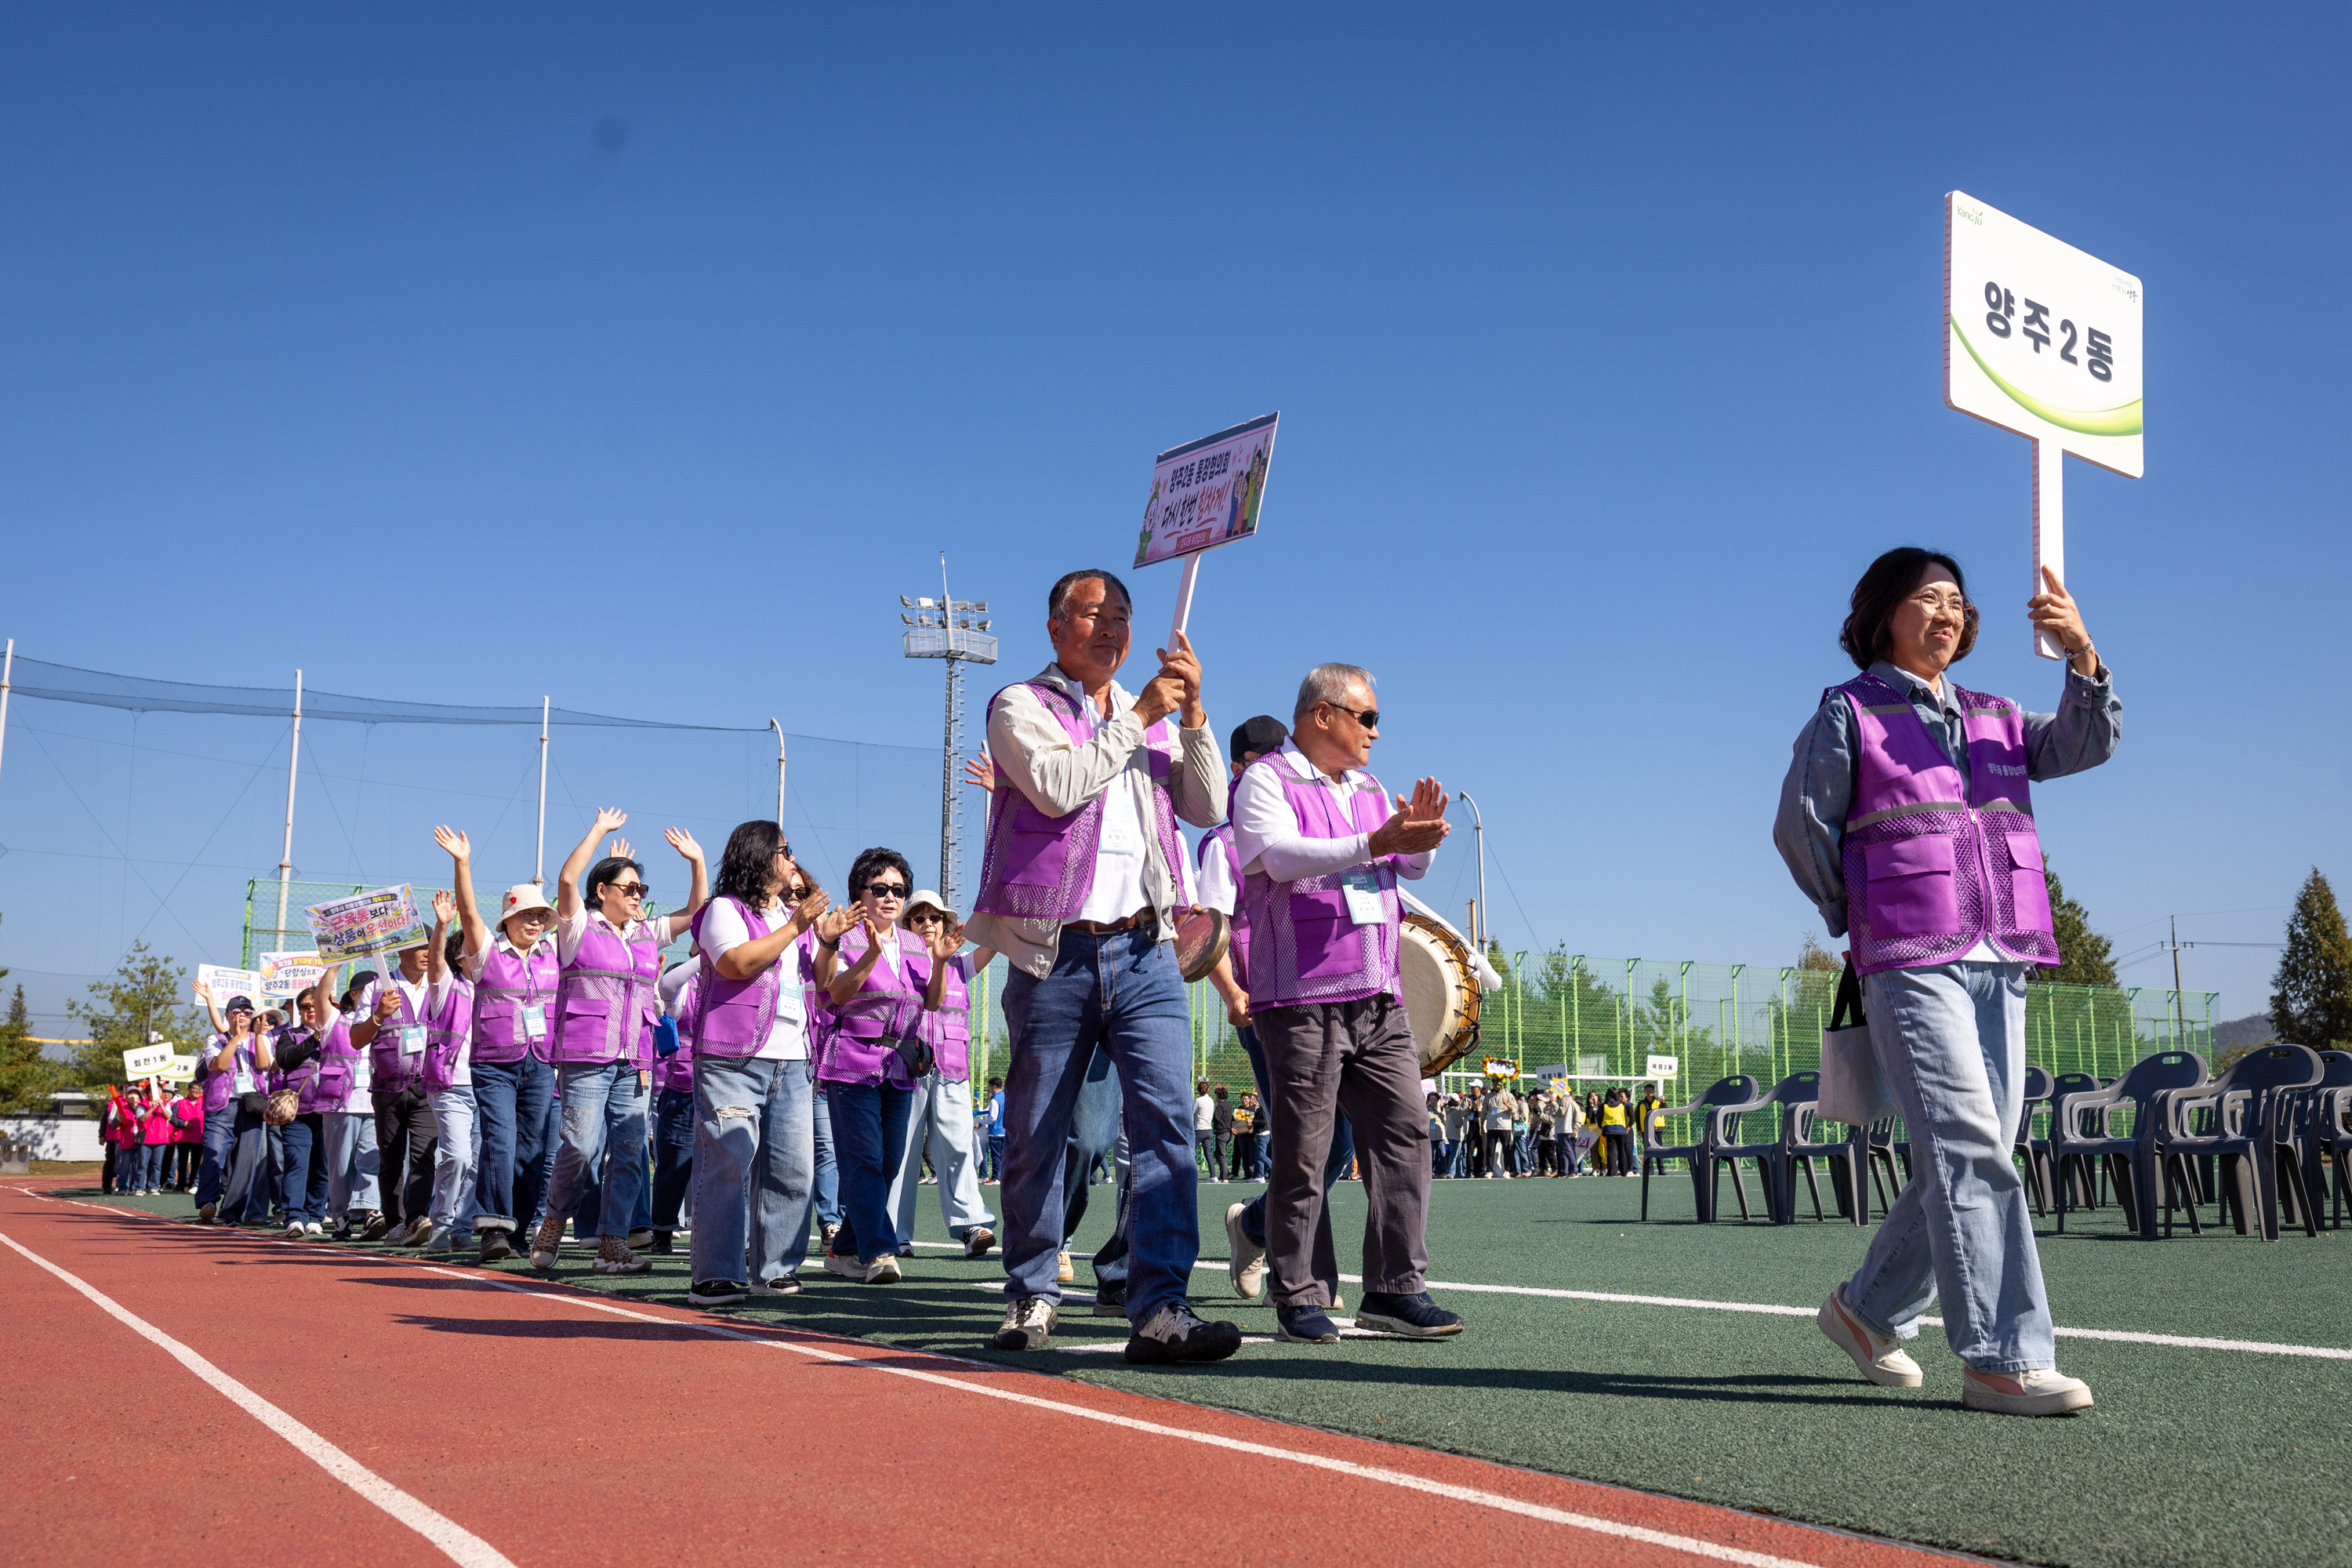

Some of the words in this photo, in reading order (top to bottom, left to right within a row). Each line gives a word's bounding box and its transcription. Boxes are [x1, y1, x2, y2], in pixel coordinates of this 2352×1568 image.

[1984, 281, 2114, 383] 양주2동
[1169, 461, 1196, 494] 양주2동
[1195, 449, 1232, 485] 통장협의회
[1161, 496, 1181, 530] 다시
[1196, 478, 1232, 523] 힘차게!
[329, 905, 345, 914] 양주시
[372, 895, 392, 904] 체육대회
[330, 904, 389, 932] 근육통보다
[332, 927, 366, 948] 상품이
[365, 913, 411, 938] 우선이다!
[370, 938, 393, 949] 통장협의회
[278, 959, 293, 968] 워크숍
[285, 967, 317, 978] 단합심으로
[212, 978, 229, 989] 양주2동
[230, 979, 252, 992] 통장협의회
[265, 979, 290, 991] 양주2동
[134, 1054, 166, 1067] 회천1동
[1541, 1072, 1563, 1080] 옥정1동
